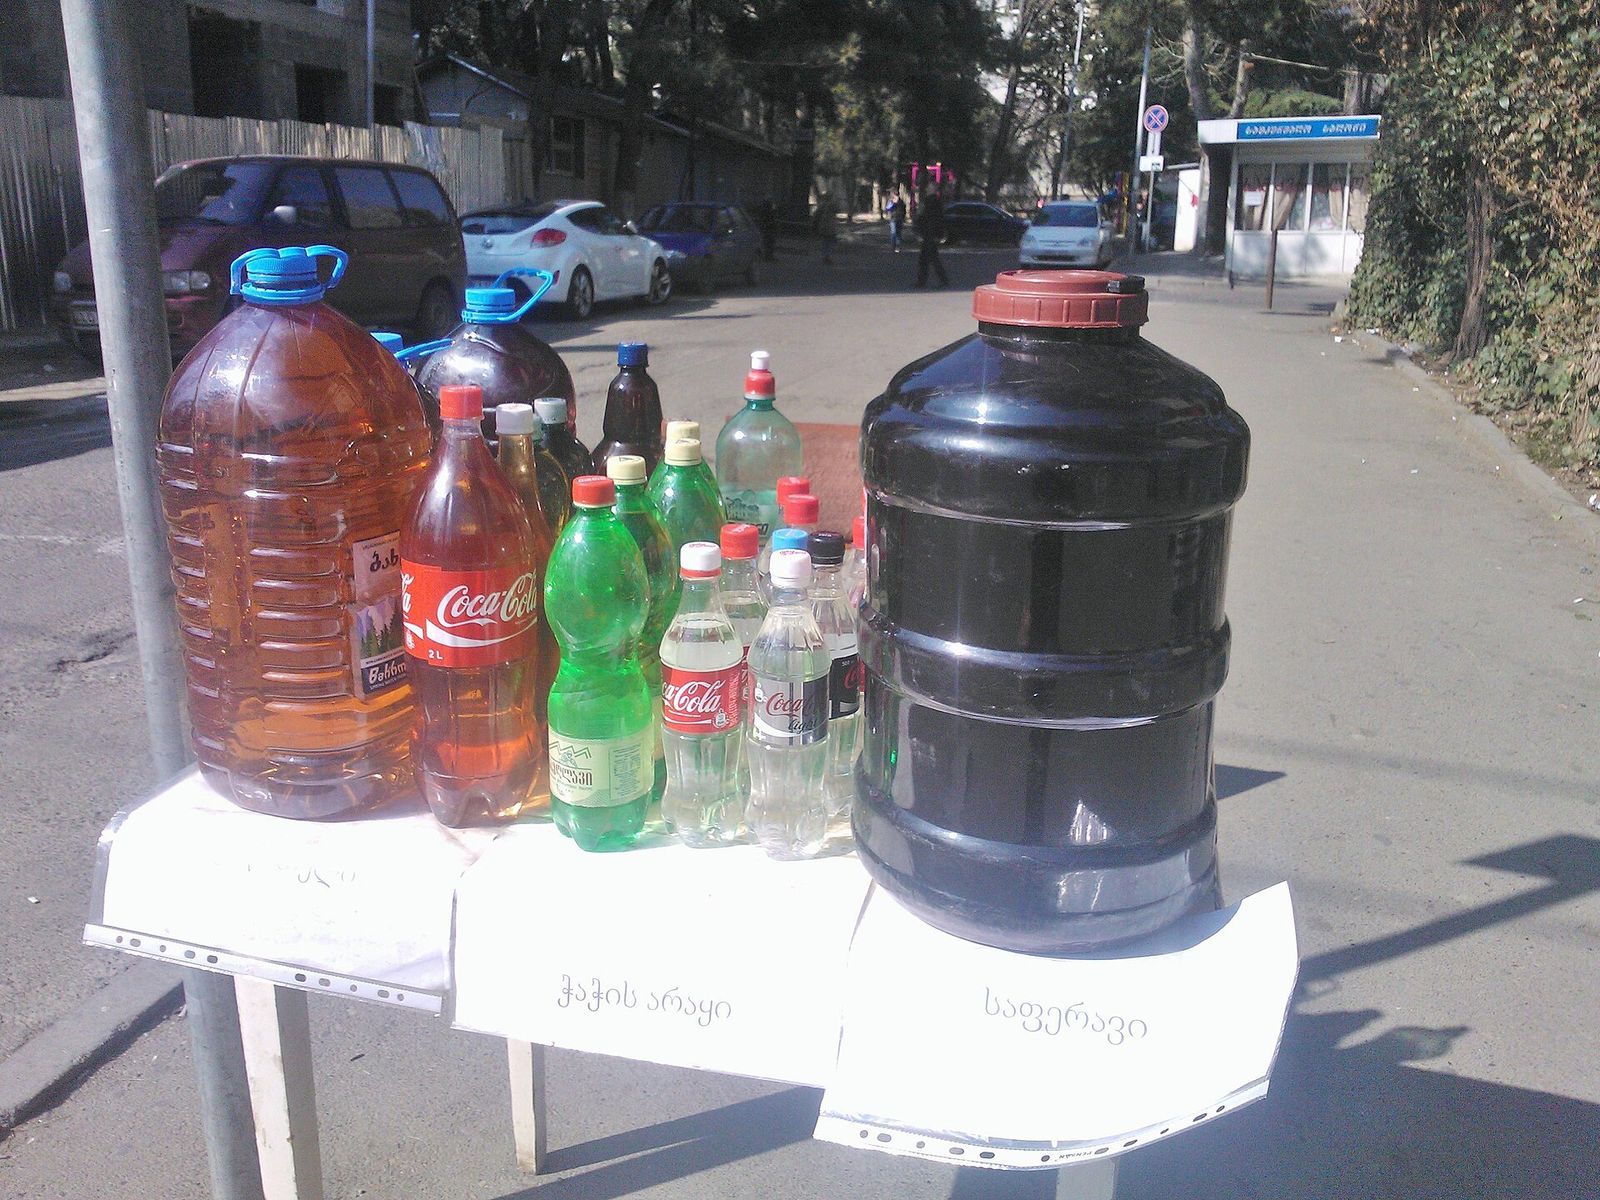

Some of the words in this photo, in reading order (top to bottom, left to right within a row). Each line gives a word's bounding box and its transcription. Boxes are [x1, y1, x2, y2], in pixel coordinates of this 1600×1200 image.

[557, 973, 638, 1012] ჭაჭის
[646, 986, 732, 1027] არაყი
[984, 986, 1148, 1046] საფერავი
